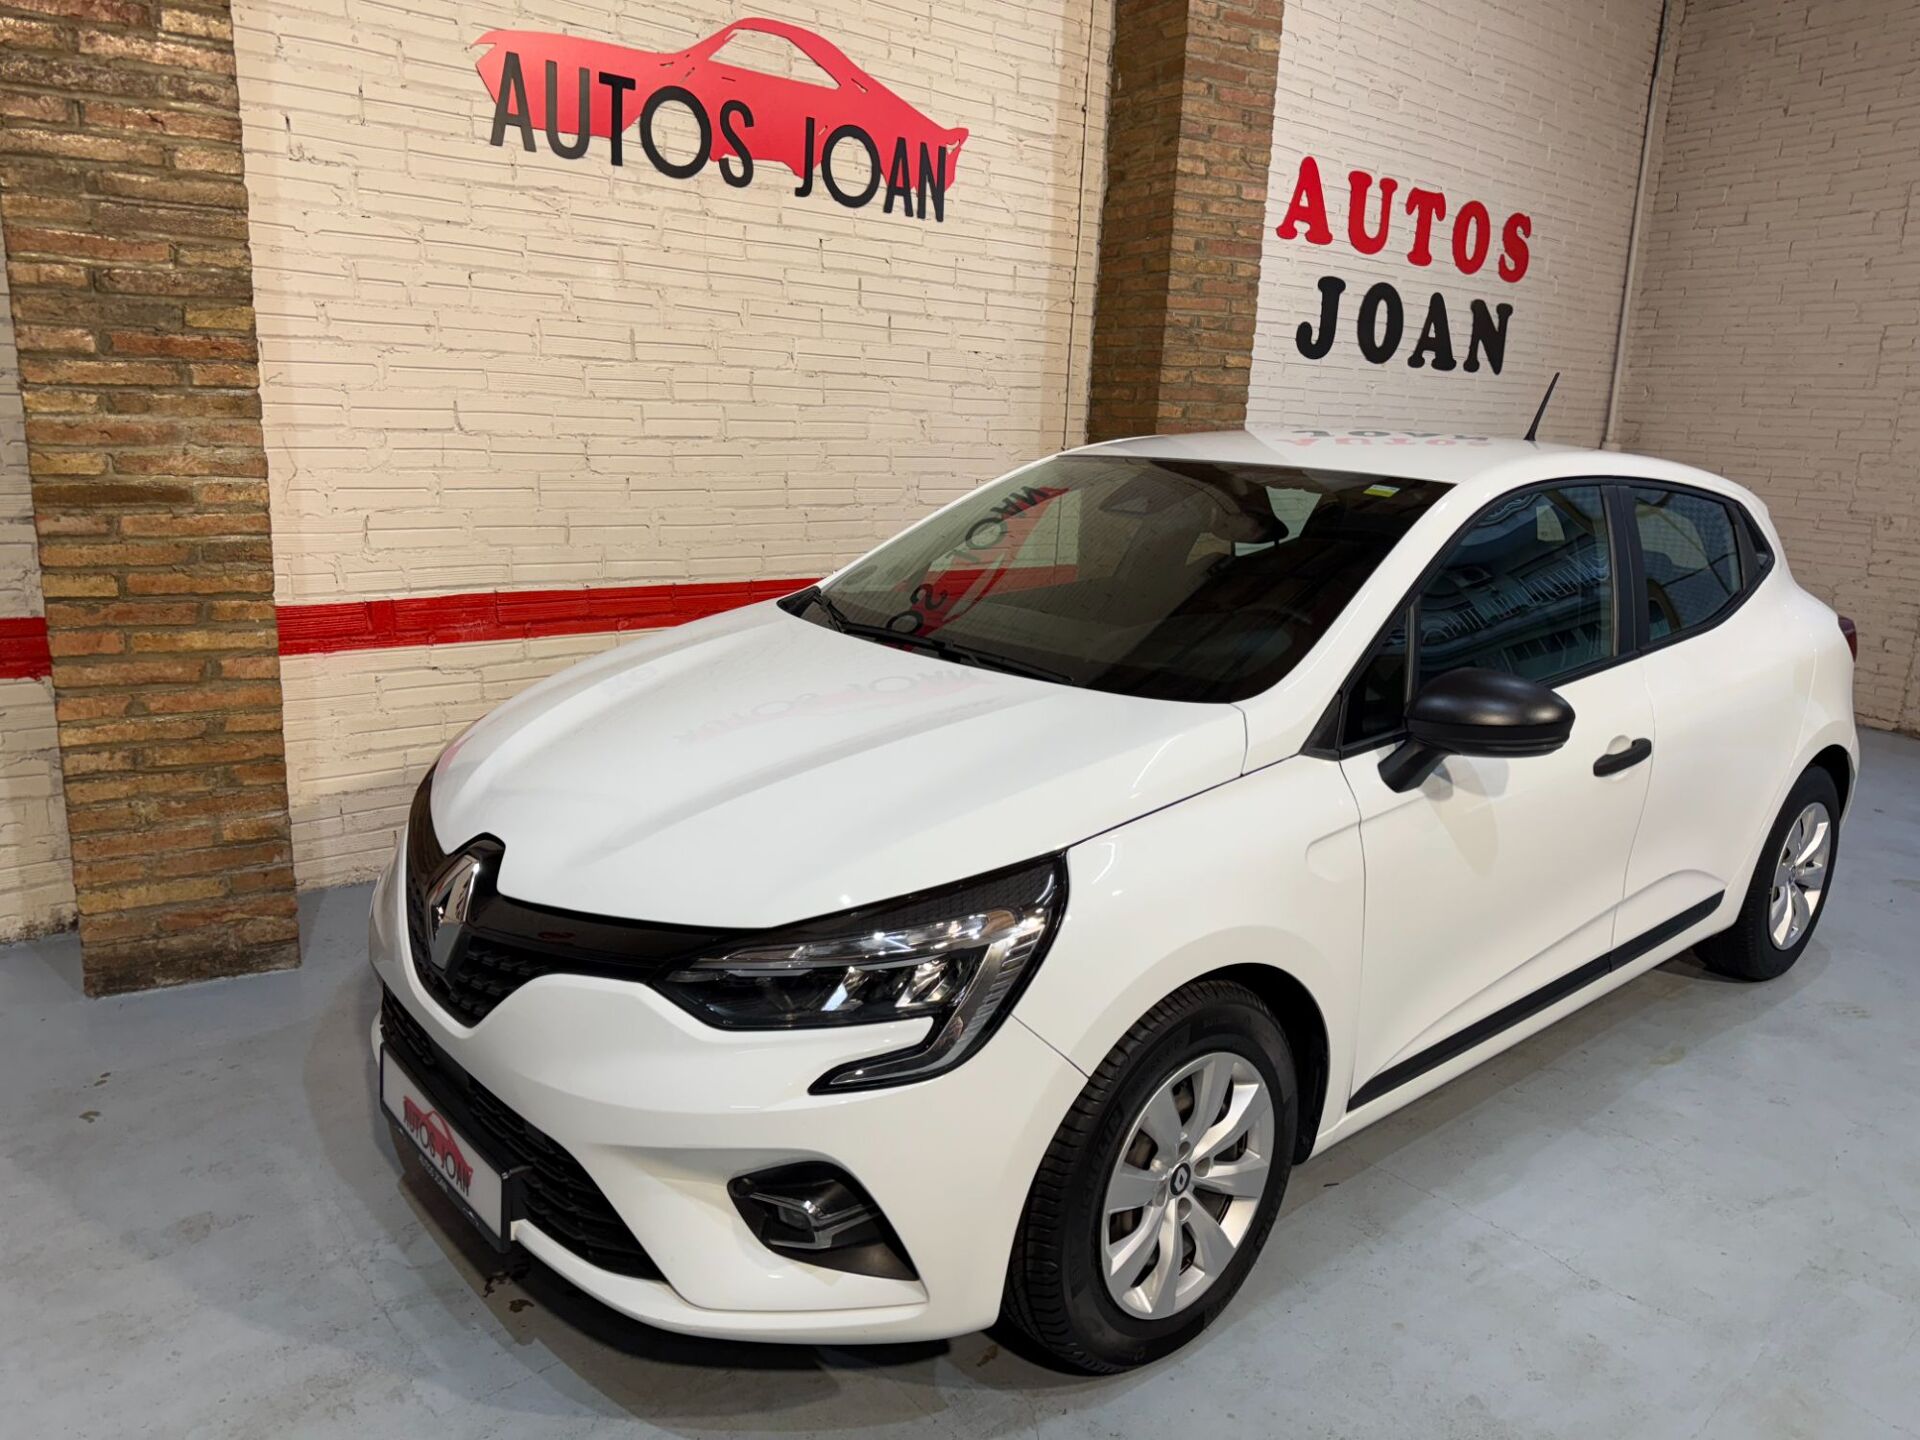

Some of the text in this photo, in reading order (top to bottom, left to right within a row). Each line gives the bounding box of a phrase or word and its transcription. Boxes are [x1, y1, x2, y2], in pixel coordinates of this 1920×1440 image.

[490, 51, 947, 223] AUTOS JOAN
[1275, 156, 1531, 283] AUTOS
[1296, 276, 1513, 375] JOAN
[404, 1101, 436, 1158] AUTOS
